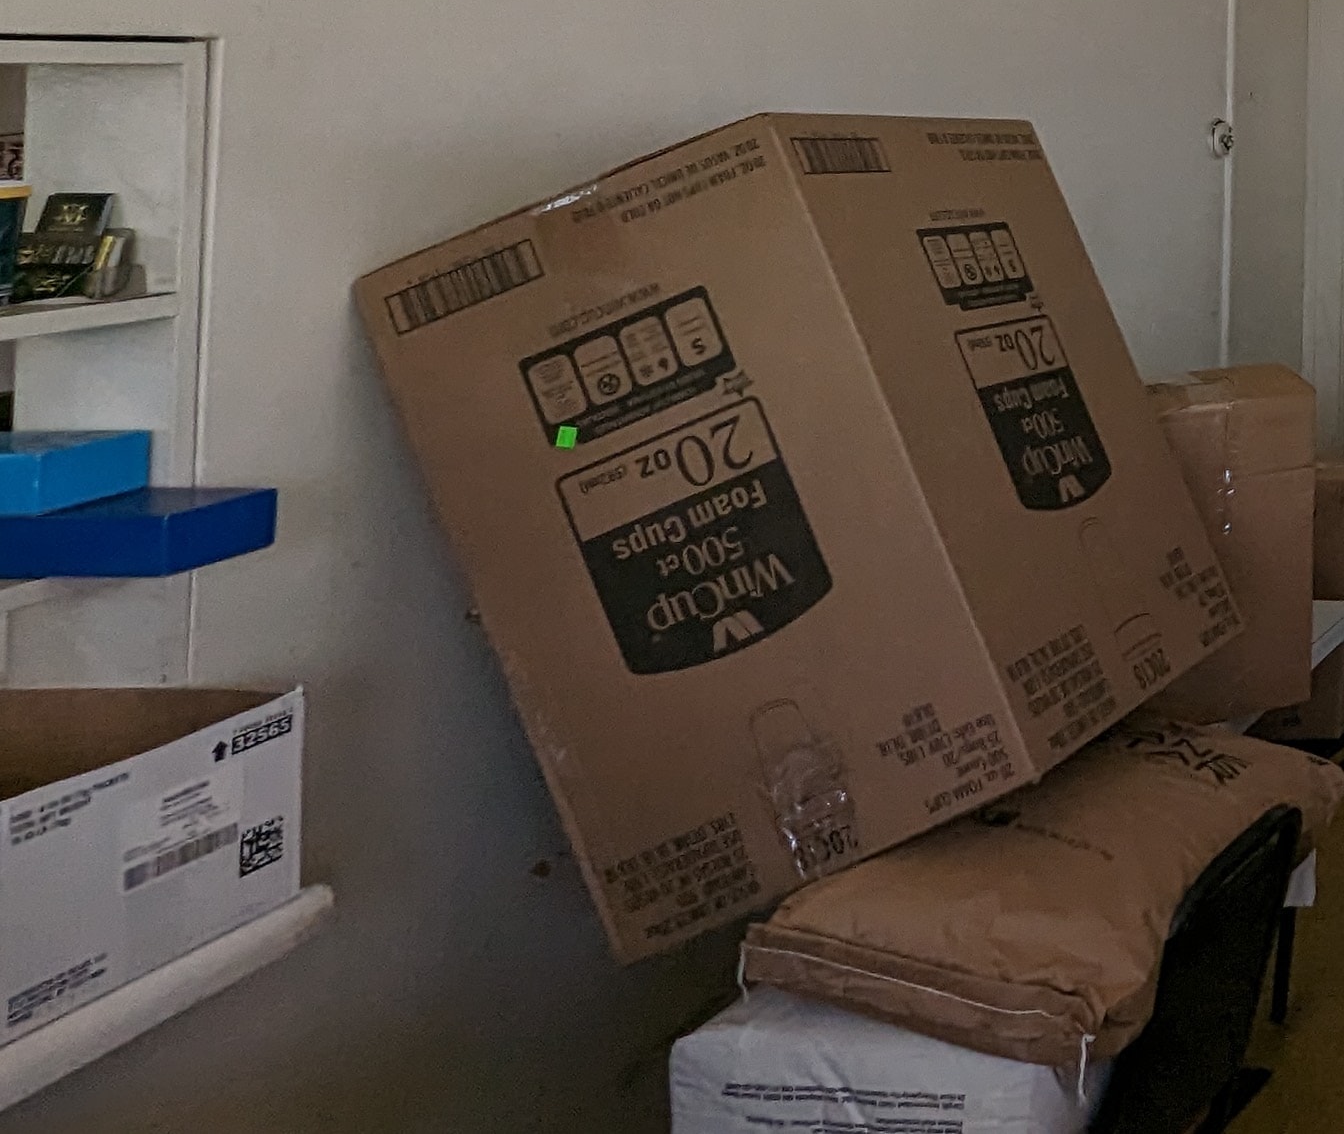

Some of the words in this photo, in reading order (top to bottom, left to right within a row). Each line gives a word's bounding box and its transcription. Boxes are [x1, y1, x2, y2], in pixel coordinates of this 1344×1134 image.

[991, 382, 1033, 415] Cups
[684, 477, 768, 528] Foam
[611, 509, 689, 562] Cups
